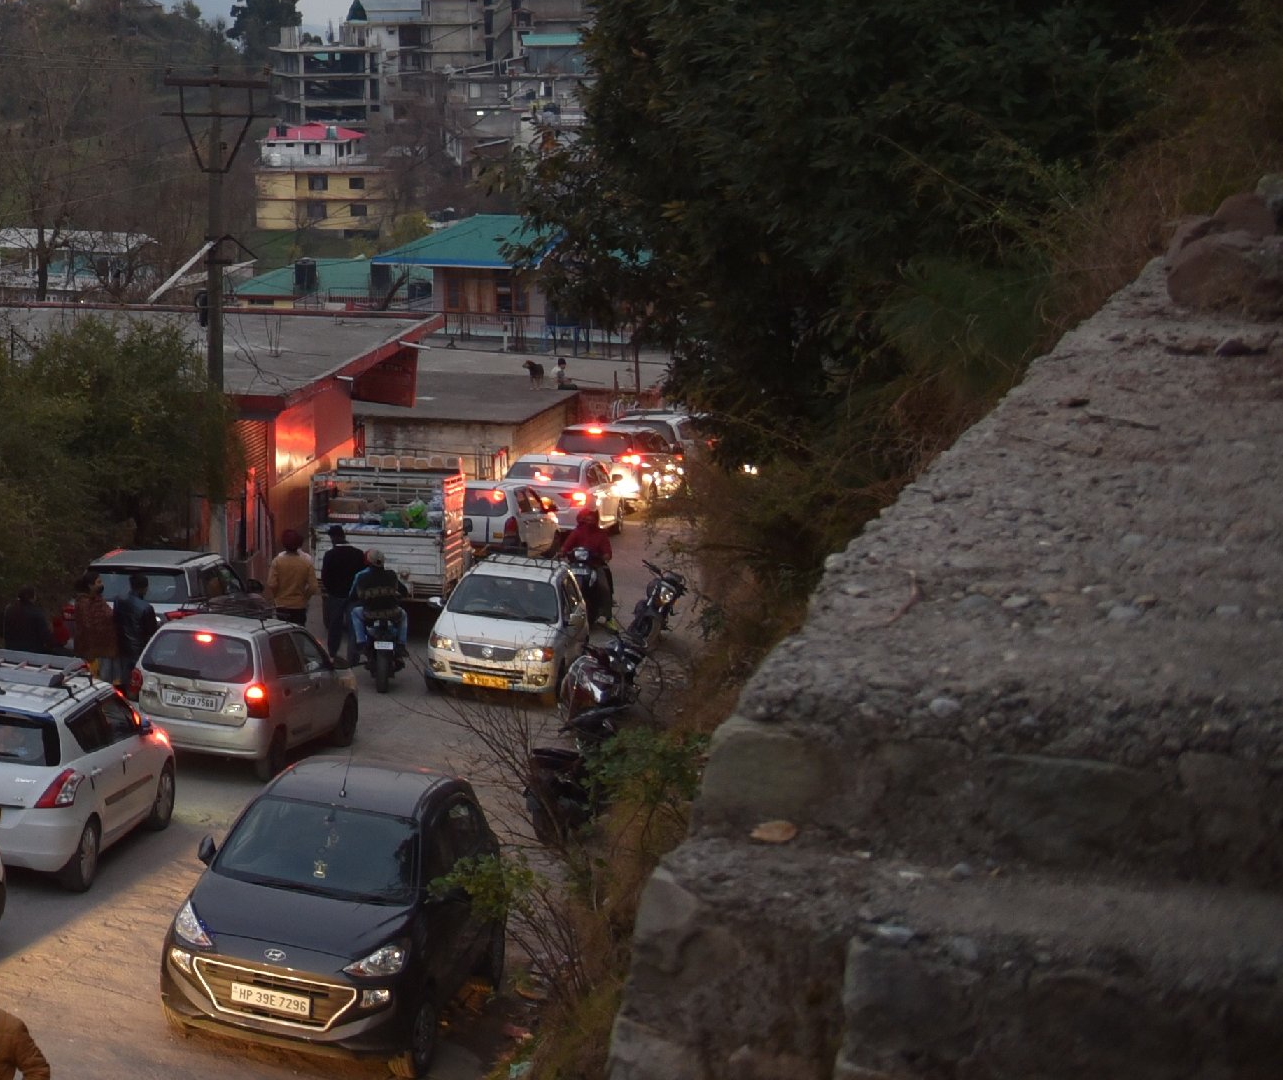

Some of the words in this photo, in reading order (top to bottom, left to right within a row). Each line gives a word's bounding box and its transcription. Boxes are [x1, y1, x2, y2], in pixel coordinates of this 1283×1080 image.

[239, 988, 253, 1000] HP
[256, 991, 276, 1006] 39E
[279, 996, 307, 1012] 7296
